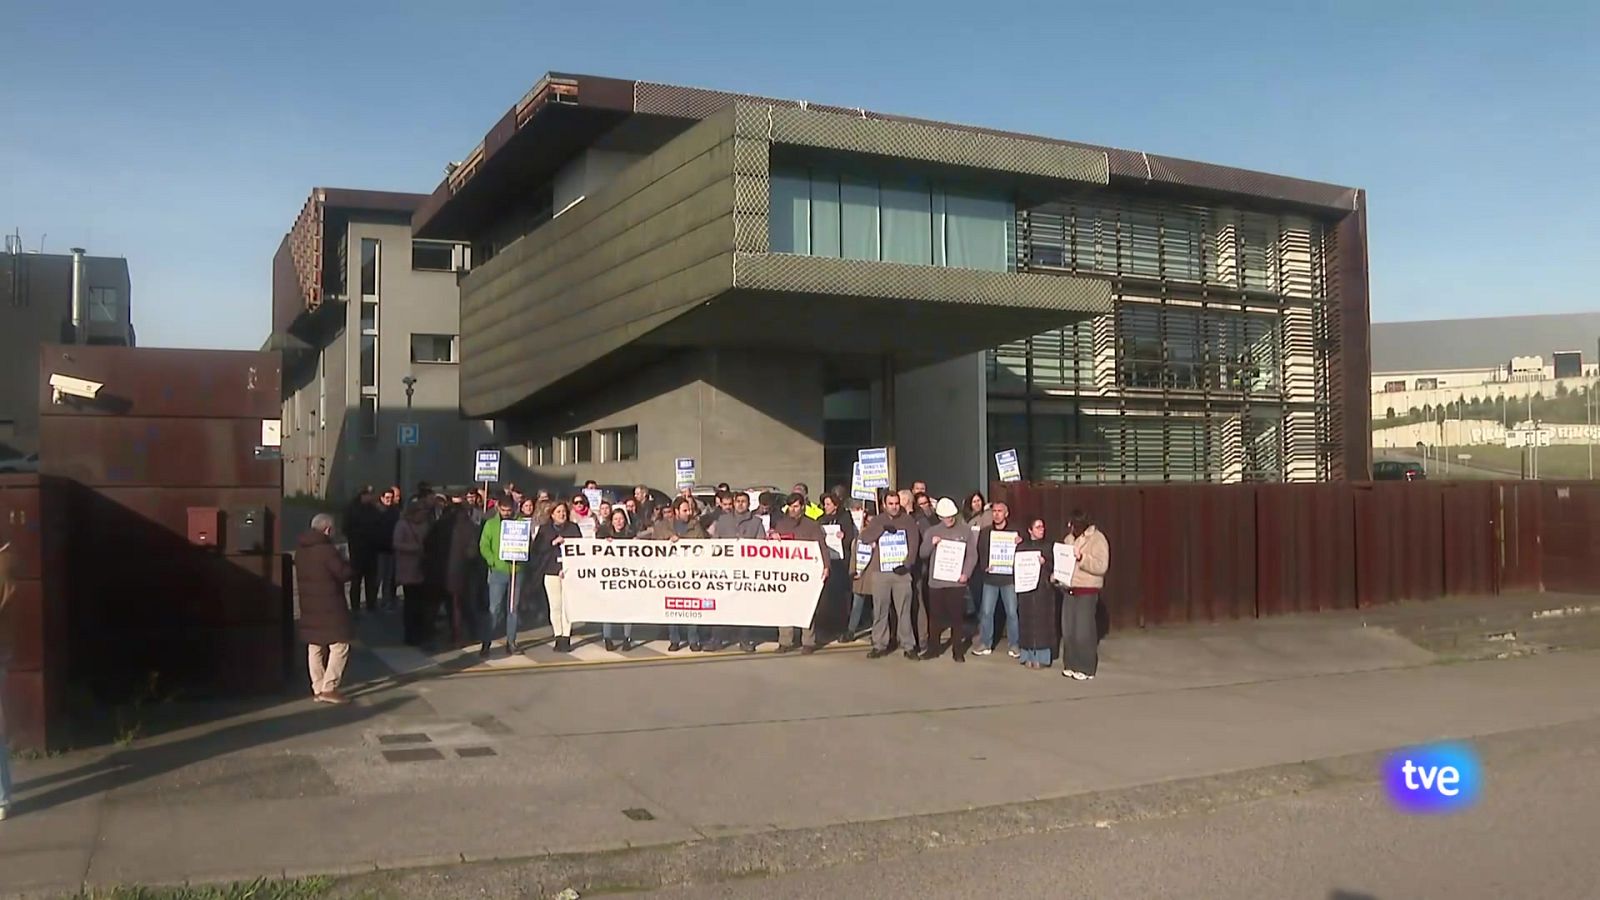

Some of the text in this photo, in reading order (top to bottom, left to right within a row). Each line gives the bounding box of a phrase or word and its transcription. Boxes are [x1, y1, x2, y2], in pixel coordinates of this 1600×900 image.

[564, 544, 819, 562] EL PATRONATO DE IDONIAL,
[577, 567, 810, 582] UN OBSTÁCULO PARA EL FUTURO
[600, 579, 787, 593] TECNOLÓGICO ASTURIANO
[666, 599, 700, 609] CCOO
